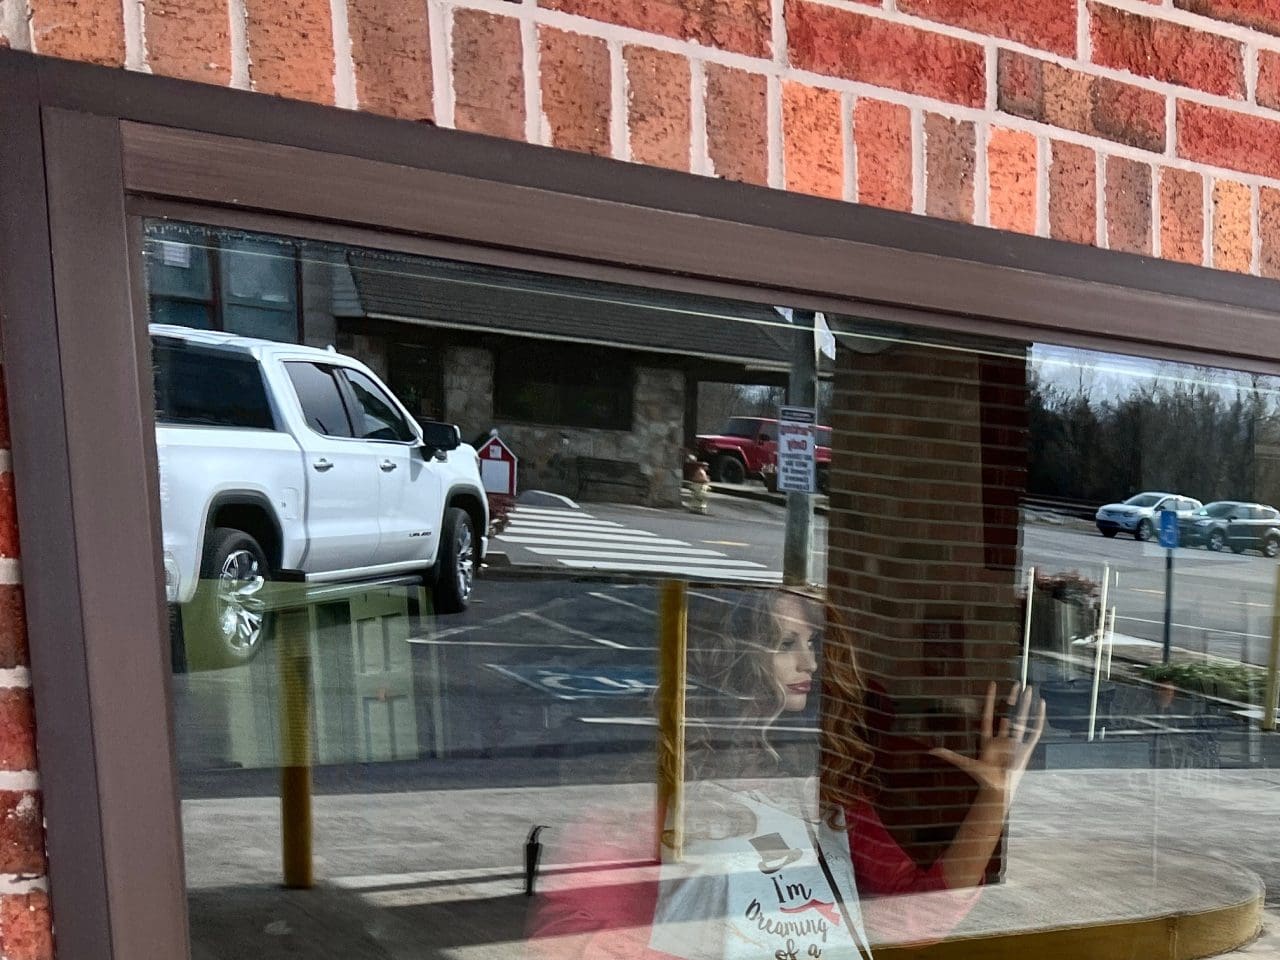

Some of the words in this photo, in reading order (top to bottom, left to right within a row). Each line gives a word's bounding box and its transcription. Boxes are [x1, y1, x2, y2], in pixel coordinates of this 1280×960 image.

[771, 874, 812, 904] I'm
[745, 898, 828, 942] Dreaming
[808, 943, 821, 958] a
